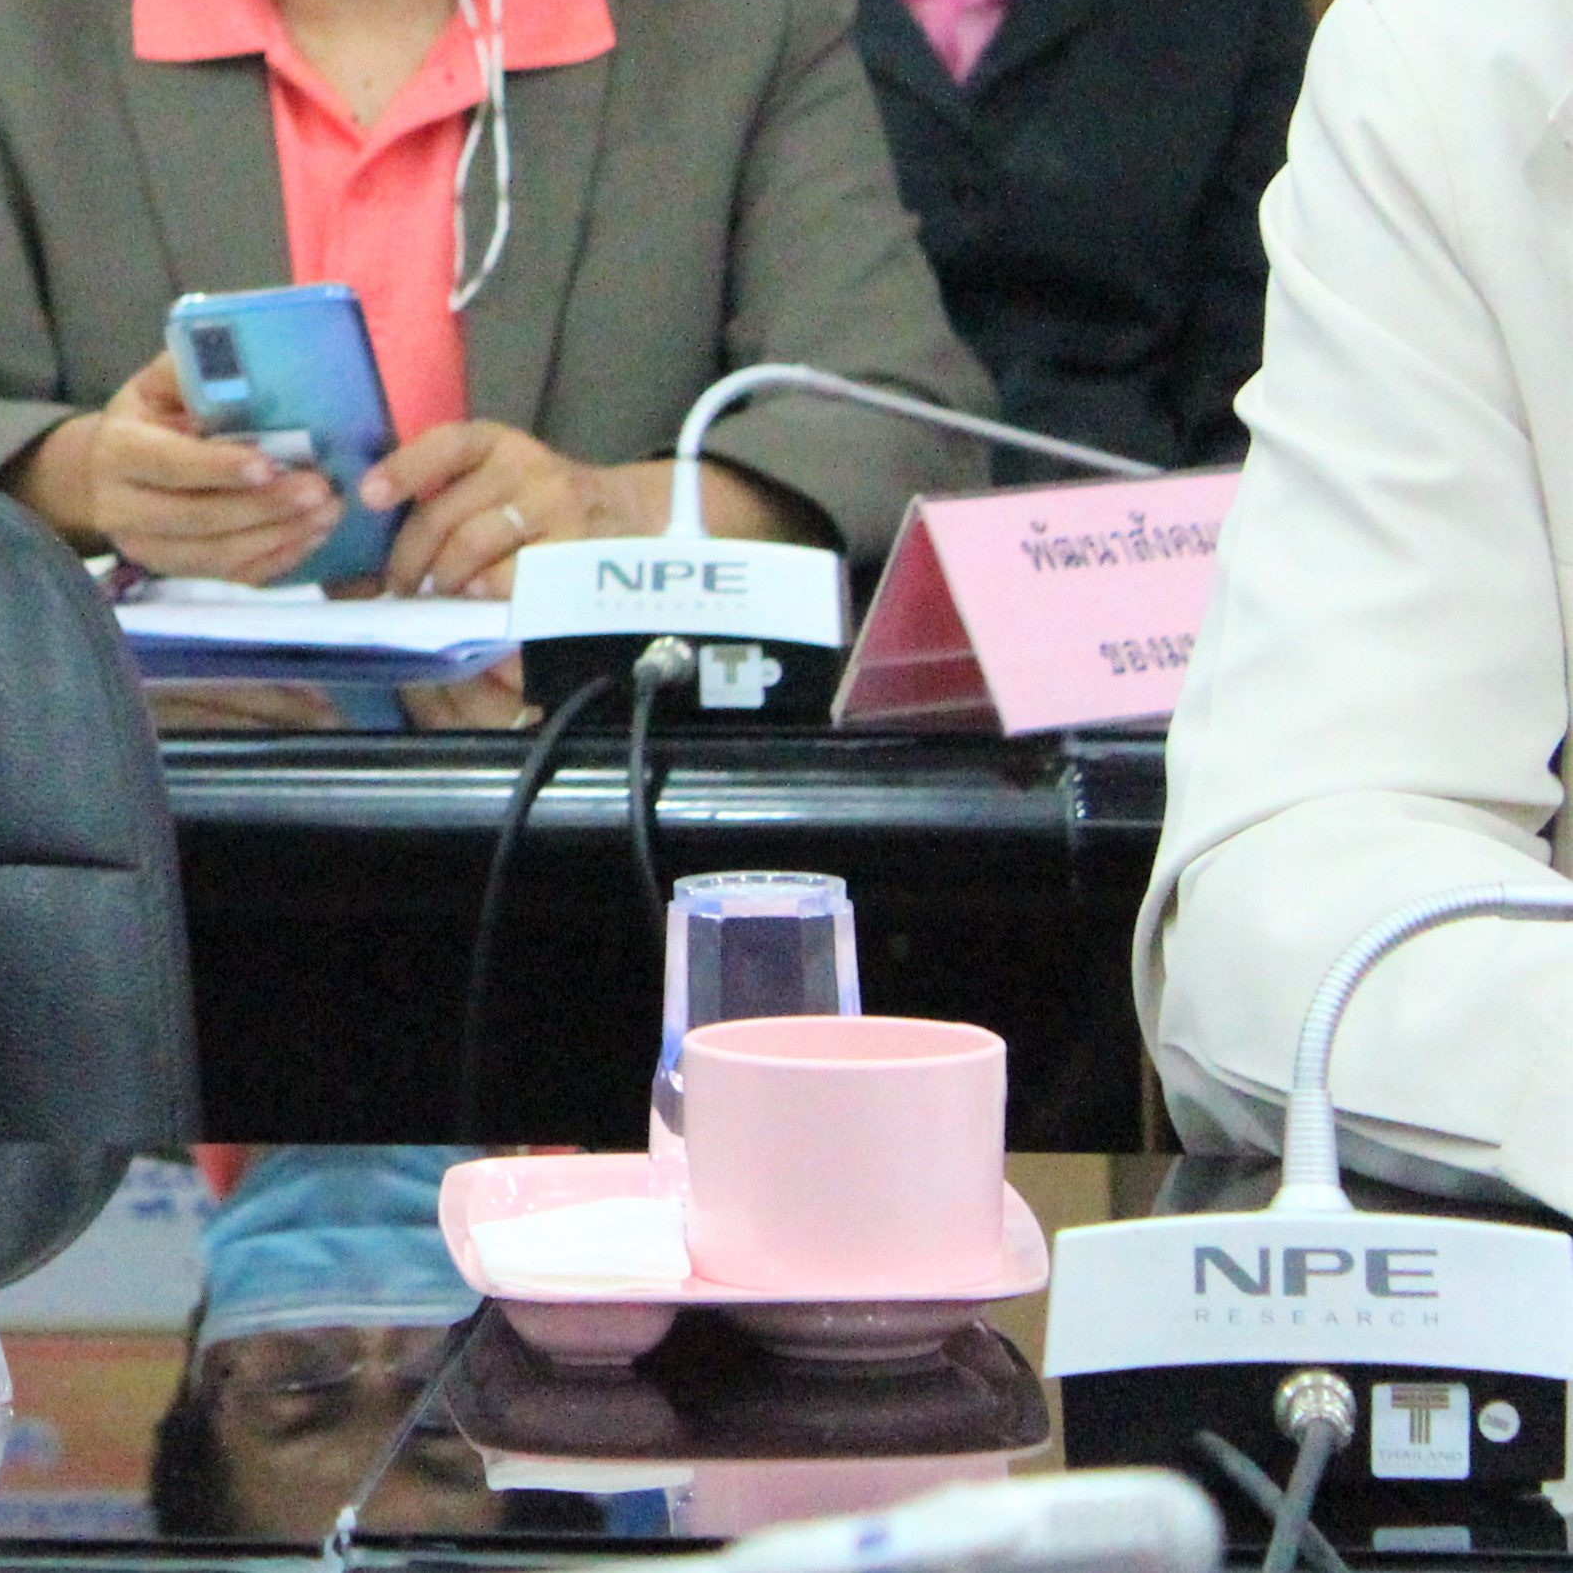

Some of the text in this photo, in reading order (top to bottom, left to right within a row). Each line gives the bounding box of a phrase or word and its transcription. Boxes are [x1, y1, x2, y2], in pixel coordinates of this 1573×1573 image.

[597, 559, 748, 594] NPE
[1194, 1246, 1440, 1298] NPE
[1194, 1309, 1440, 1327] RESEARCH
